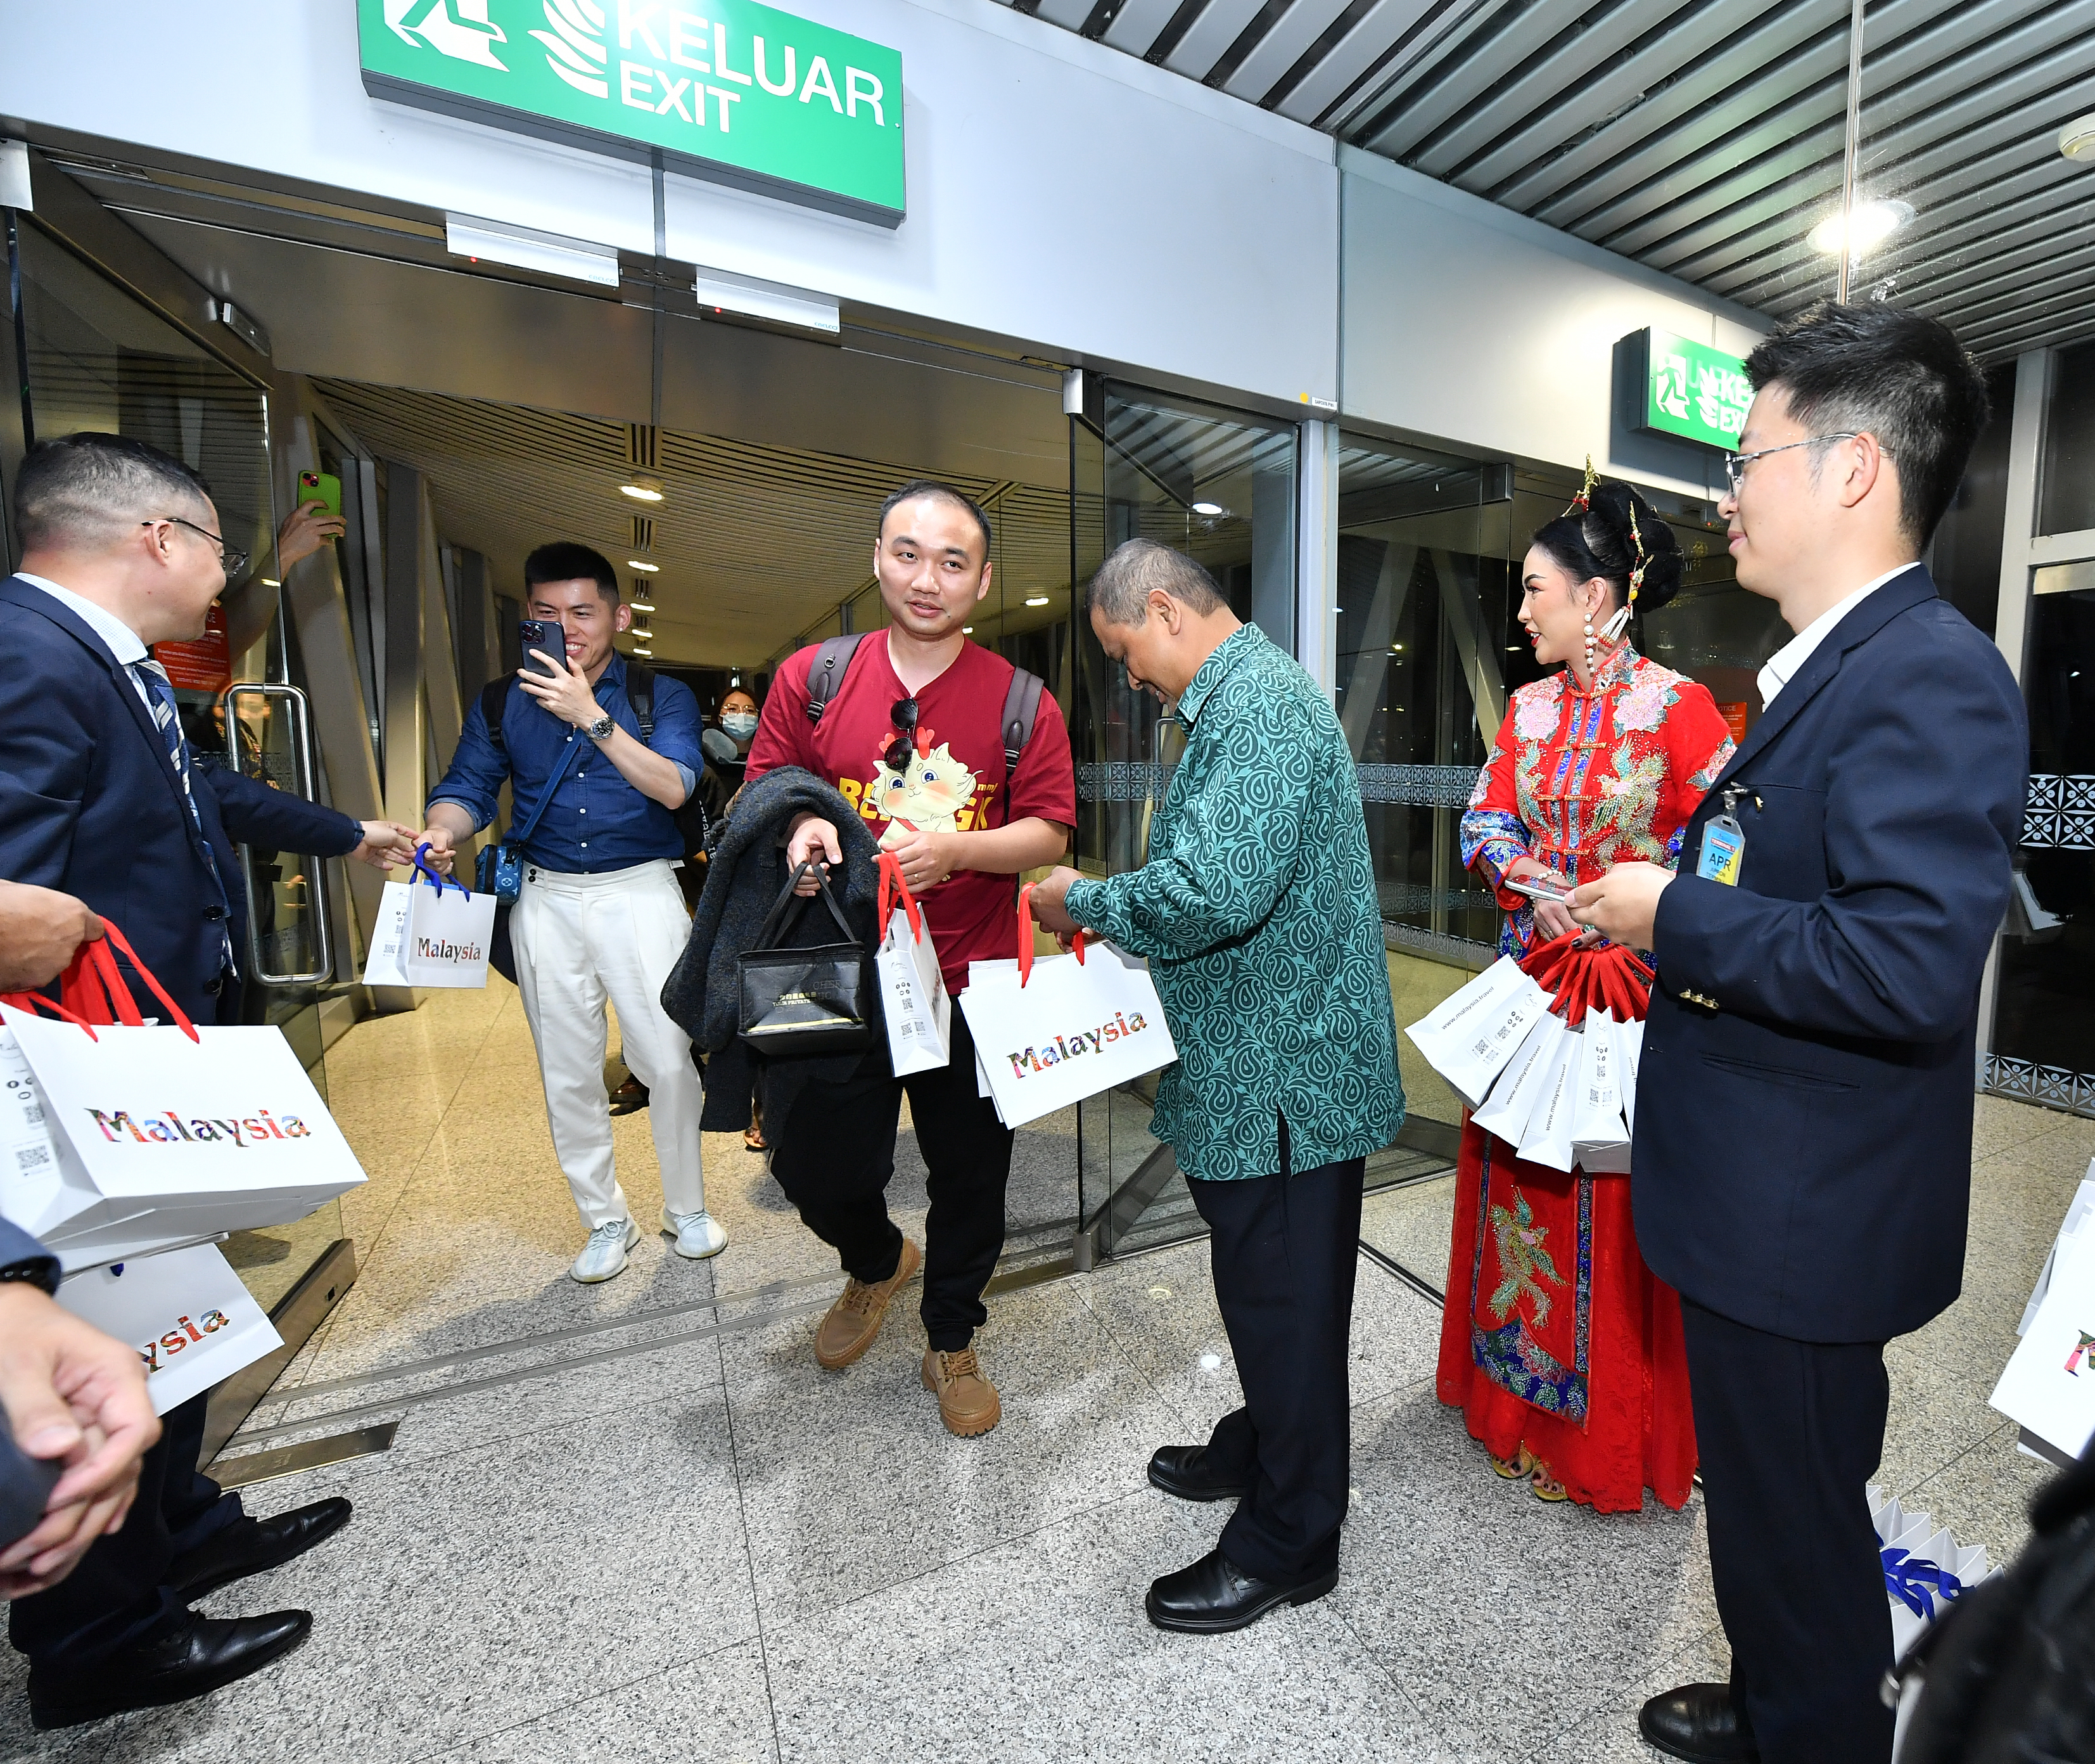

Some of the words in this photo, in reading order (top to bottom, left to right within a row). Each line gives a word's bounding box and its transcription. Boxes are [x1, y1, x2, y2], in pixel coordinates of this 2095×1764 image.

[618, 0, 886, 127] KELUAR
[620, 59, 742, 133] EXIT
[1709, 853, 1731, 872] APR
[417, 937, 481, 963] Malaysia
[1441, 985, 1495, 1031] www.malaysia.travel
[1006, 1011, 1148, 1079] Malaysia
[1505, 1044, 1541, 1106] www.malaysia.travel
[84, 1108, 312, 1147] Malaysia
[1545, 1063, 1567, 1132] www.malaysia.travel
[141, 1308, 231, 1374] ysia
